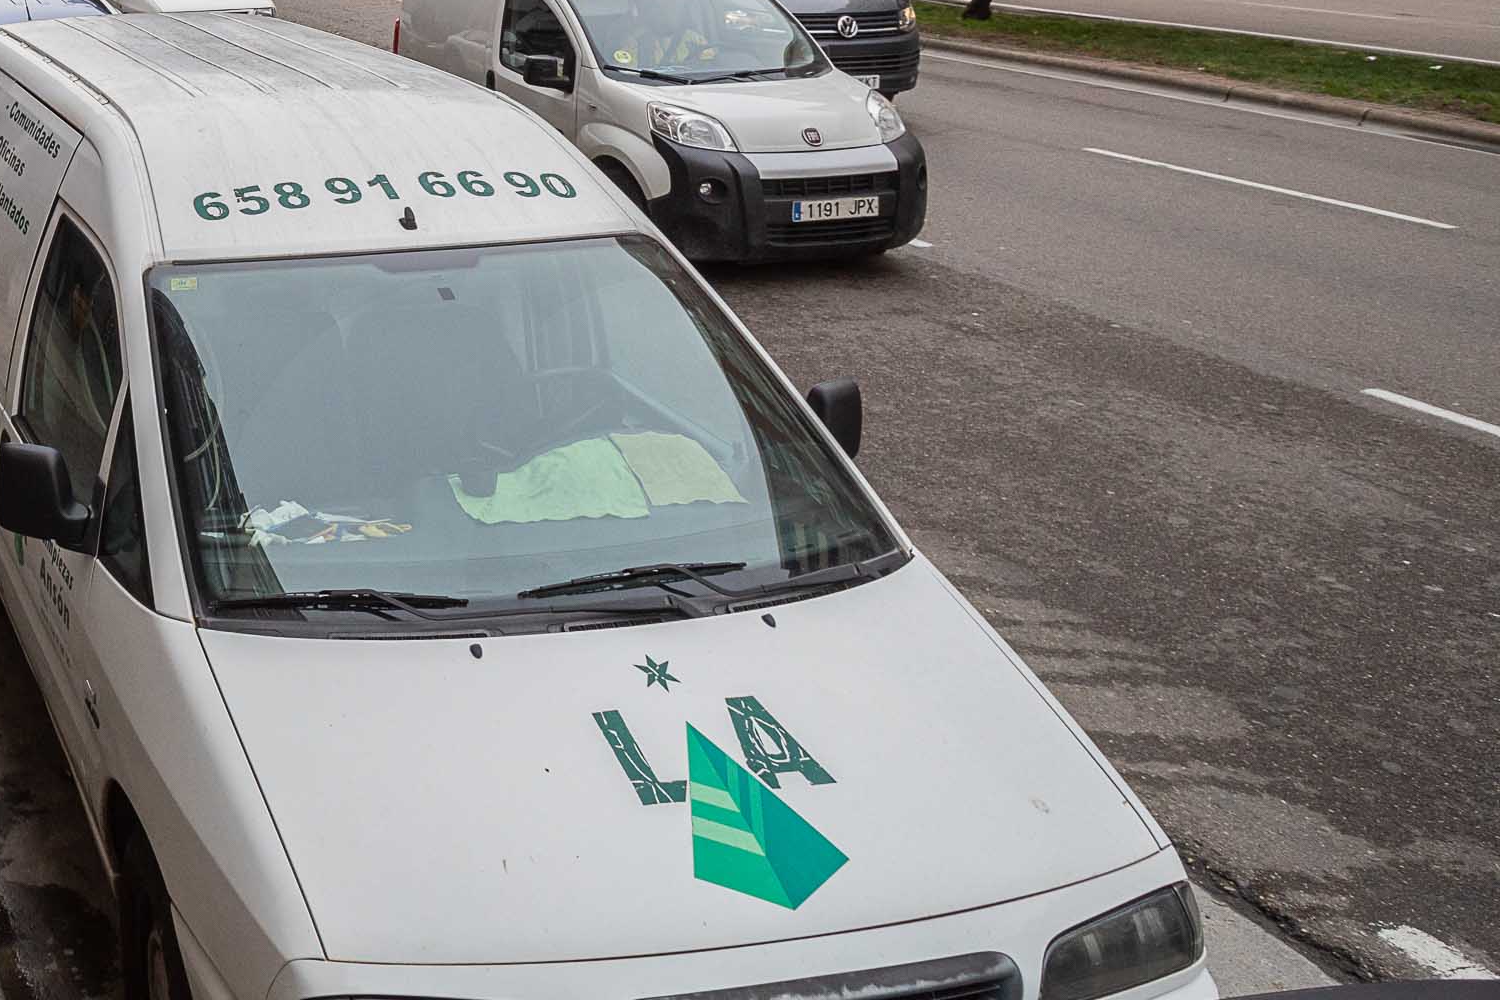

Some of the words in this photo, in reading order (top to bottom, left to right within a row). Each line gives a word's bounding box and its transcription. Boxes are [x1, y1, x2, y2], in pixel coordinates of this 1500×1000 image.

[9, 101, 61, 159] Comunidades
[193, 181, 311, 221] 658
[324, 173, 401, 204] 91
[417, 170, 496, 198] 66
[502, 171, 578, 199] 90
[807, 201, 840, 219] 1191
[848, 198, 876, 216] JPX
[39, 557, 71, 631] Ansón
